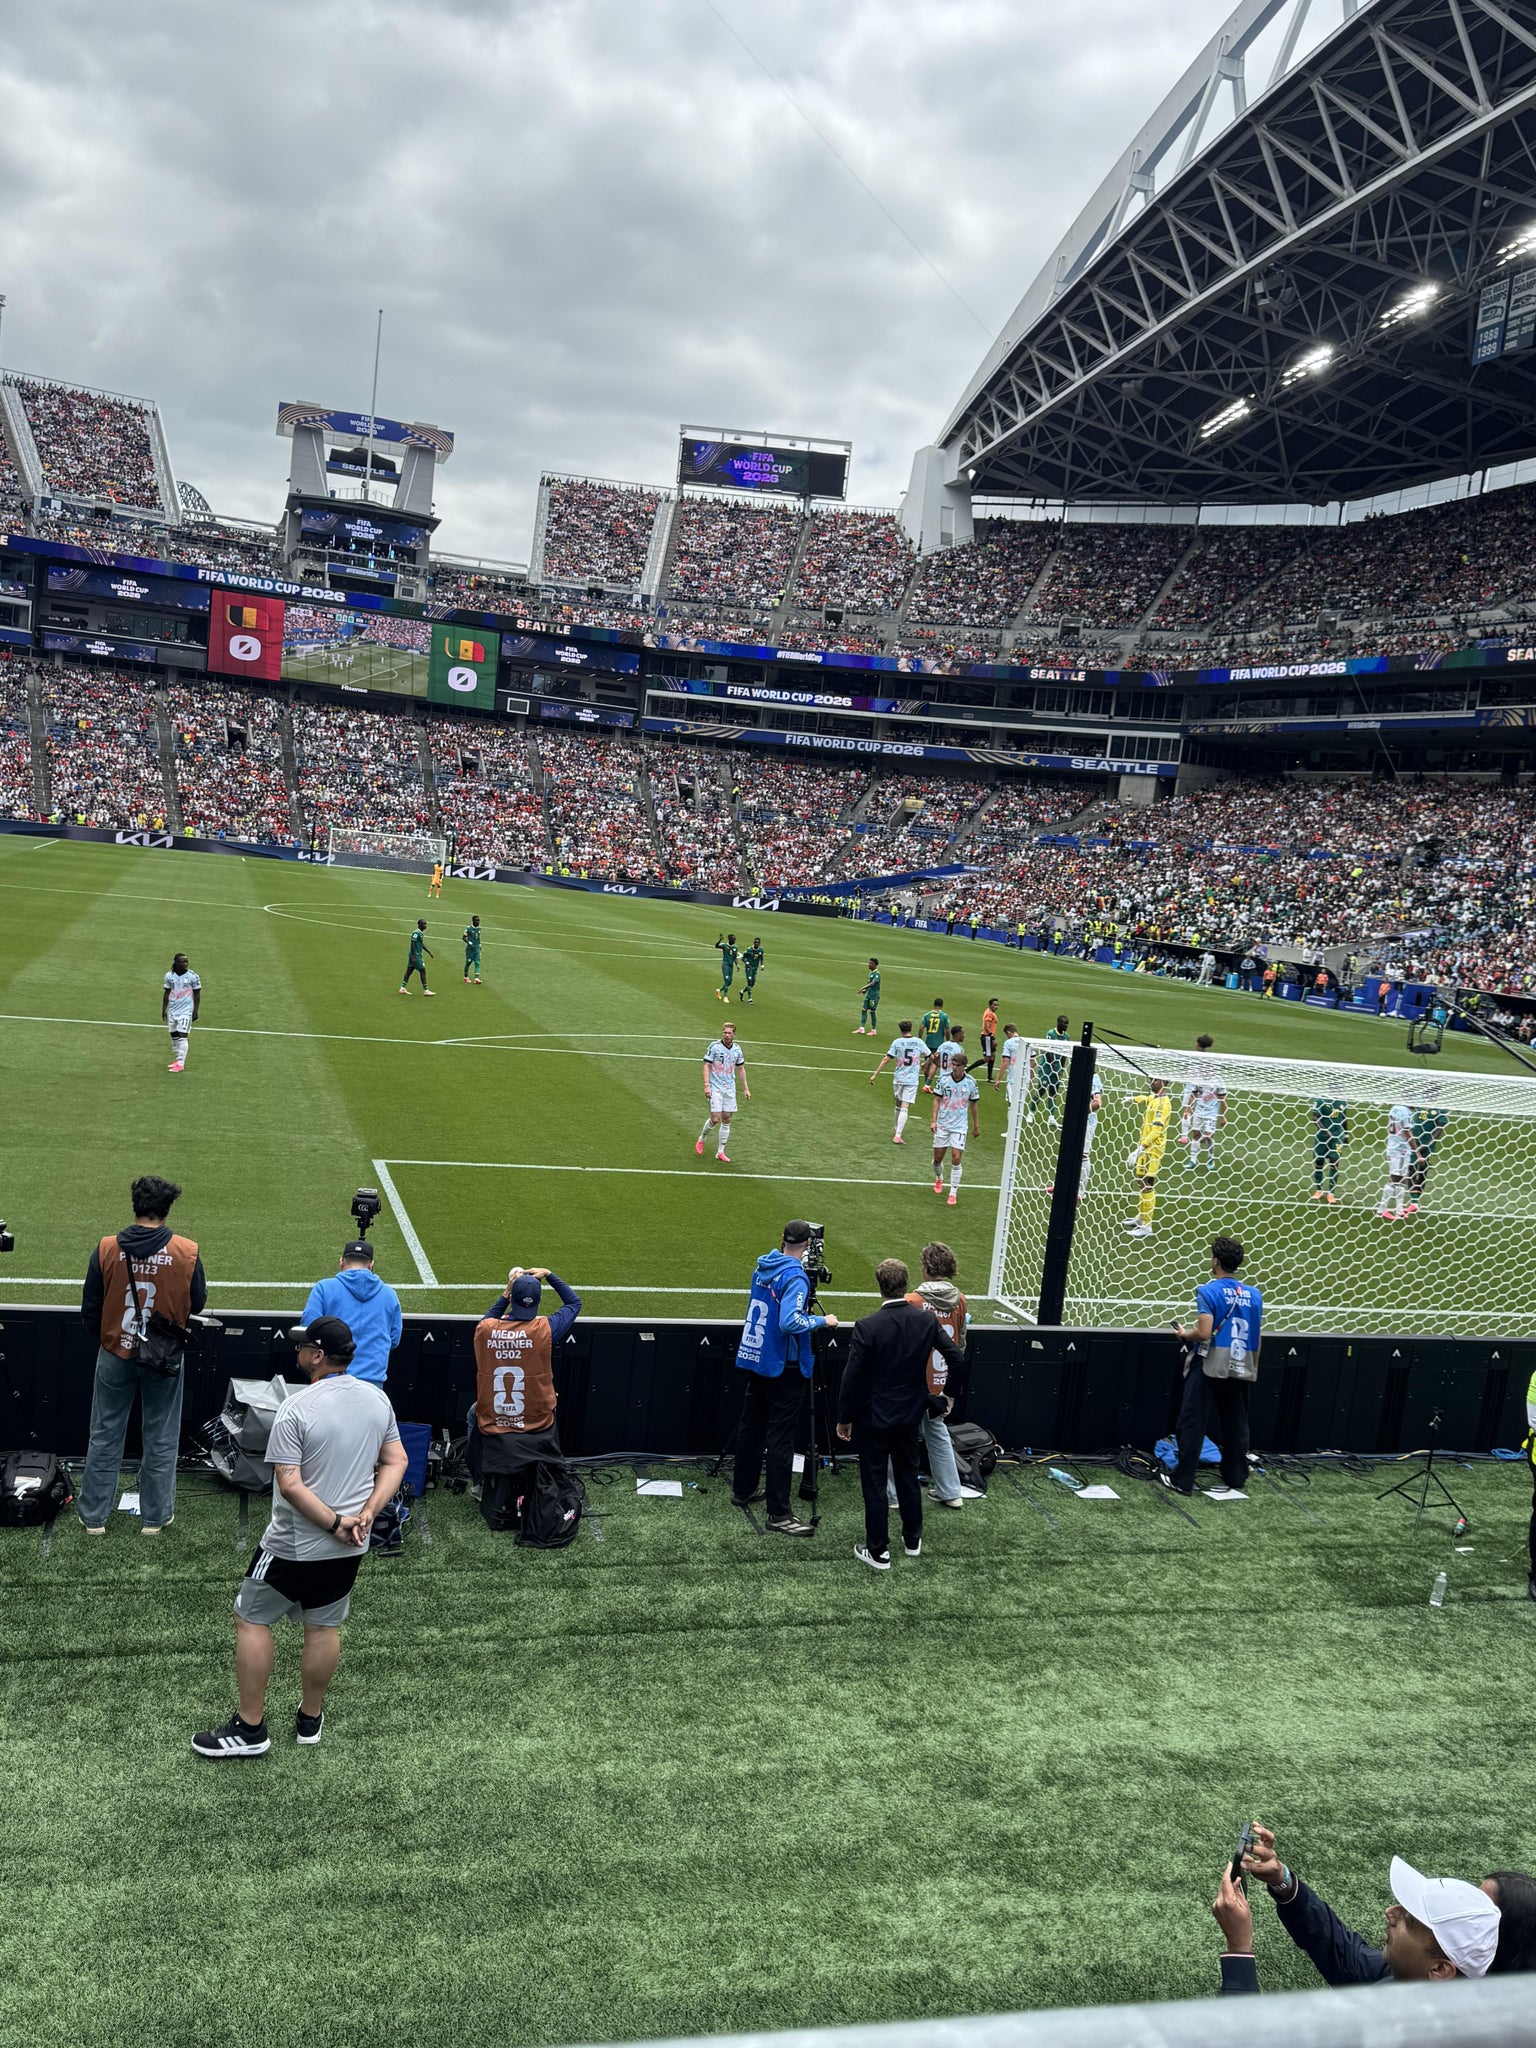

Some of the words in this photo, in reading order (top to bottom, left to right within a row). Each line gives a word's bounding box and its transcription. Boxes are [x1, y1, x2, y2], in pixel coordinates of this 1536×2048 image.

[1479, 327, 1499, 344] 1988
[1477, 342, 1498, 358] 1999
[752, 452, 774, 463] FIFA
[733, 459, 770, 472] WORLD
[771, 464, 793, 474] CUP
[742, 471, 780, 484] 2026
[345, 523, 369, 534] WORLD
[370, 528, 384, 536] CUP
[356, 520, 372, 528] FIFA
[110, 583, 134, 592] WORLD
[135, 586, 149, 594] CUP
[122, 579, 138, 587] FIFA
[198, 569, 226, 584] FIFA
[228, 574, 274, 591] WORLD
[274, 582, 300, 595] CUP
[302, 586, 346, 602] 2026
[516, 619, 571, 635] SEATTLE
[1506, 647, 1536, 662] SEA
[1029, 668, 1086, 682] SEATTLE
[1230, 668, 1250, 681] FIFA
[1252, 666, 1288, 679] WORLD
[1288, 665, 1310, 677] CUP
[1309, 662, 1346, 676] 2026
[341, 684, 368, 694] Hisense
[727, 686, 751, 700] FIFA
[752, 688, 790, 700] WORLD
[791, 692, 814, 702] CUP
[814, 694, 852, 706] 2026
[785, 734, 811, 747] FIFA
[812, 737, 856, 750] WORLD
[856, 741, 881, 752] CUP
[882, 744, 924, 756] 2026
[1070, 758, 1159, 776] SEATTLE
[915, 919, 928, 929] FIFA
[928, 1018, 940, 1033] 13
[904, 1048, 914, 1066] 5
[942, 1052, 948, 1070] 8
[491, 1330, 527, 1339] MEDIA
[746, 1336, 757, 1344] FIFA
[487, 1340, 533, 1348] PARTNER
[496, 1350, 522, 1359] 0502
[738, 1350, 760, 1362] 2026
